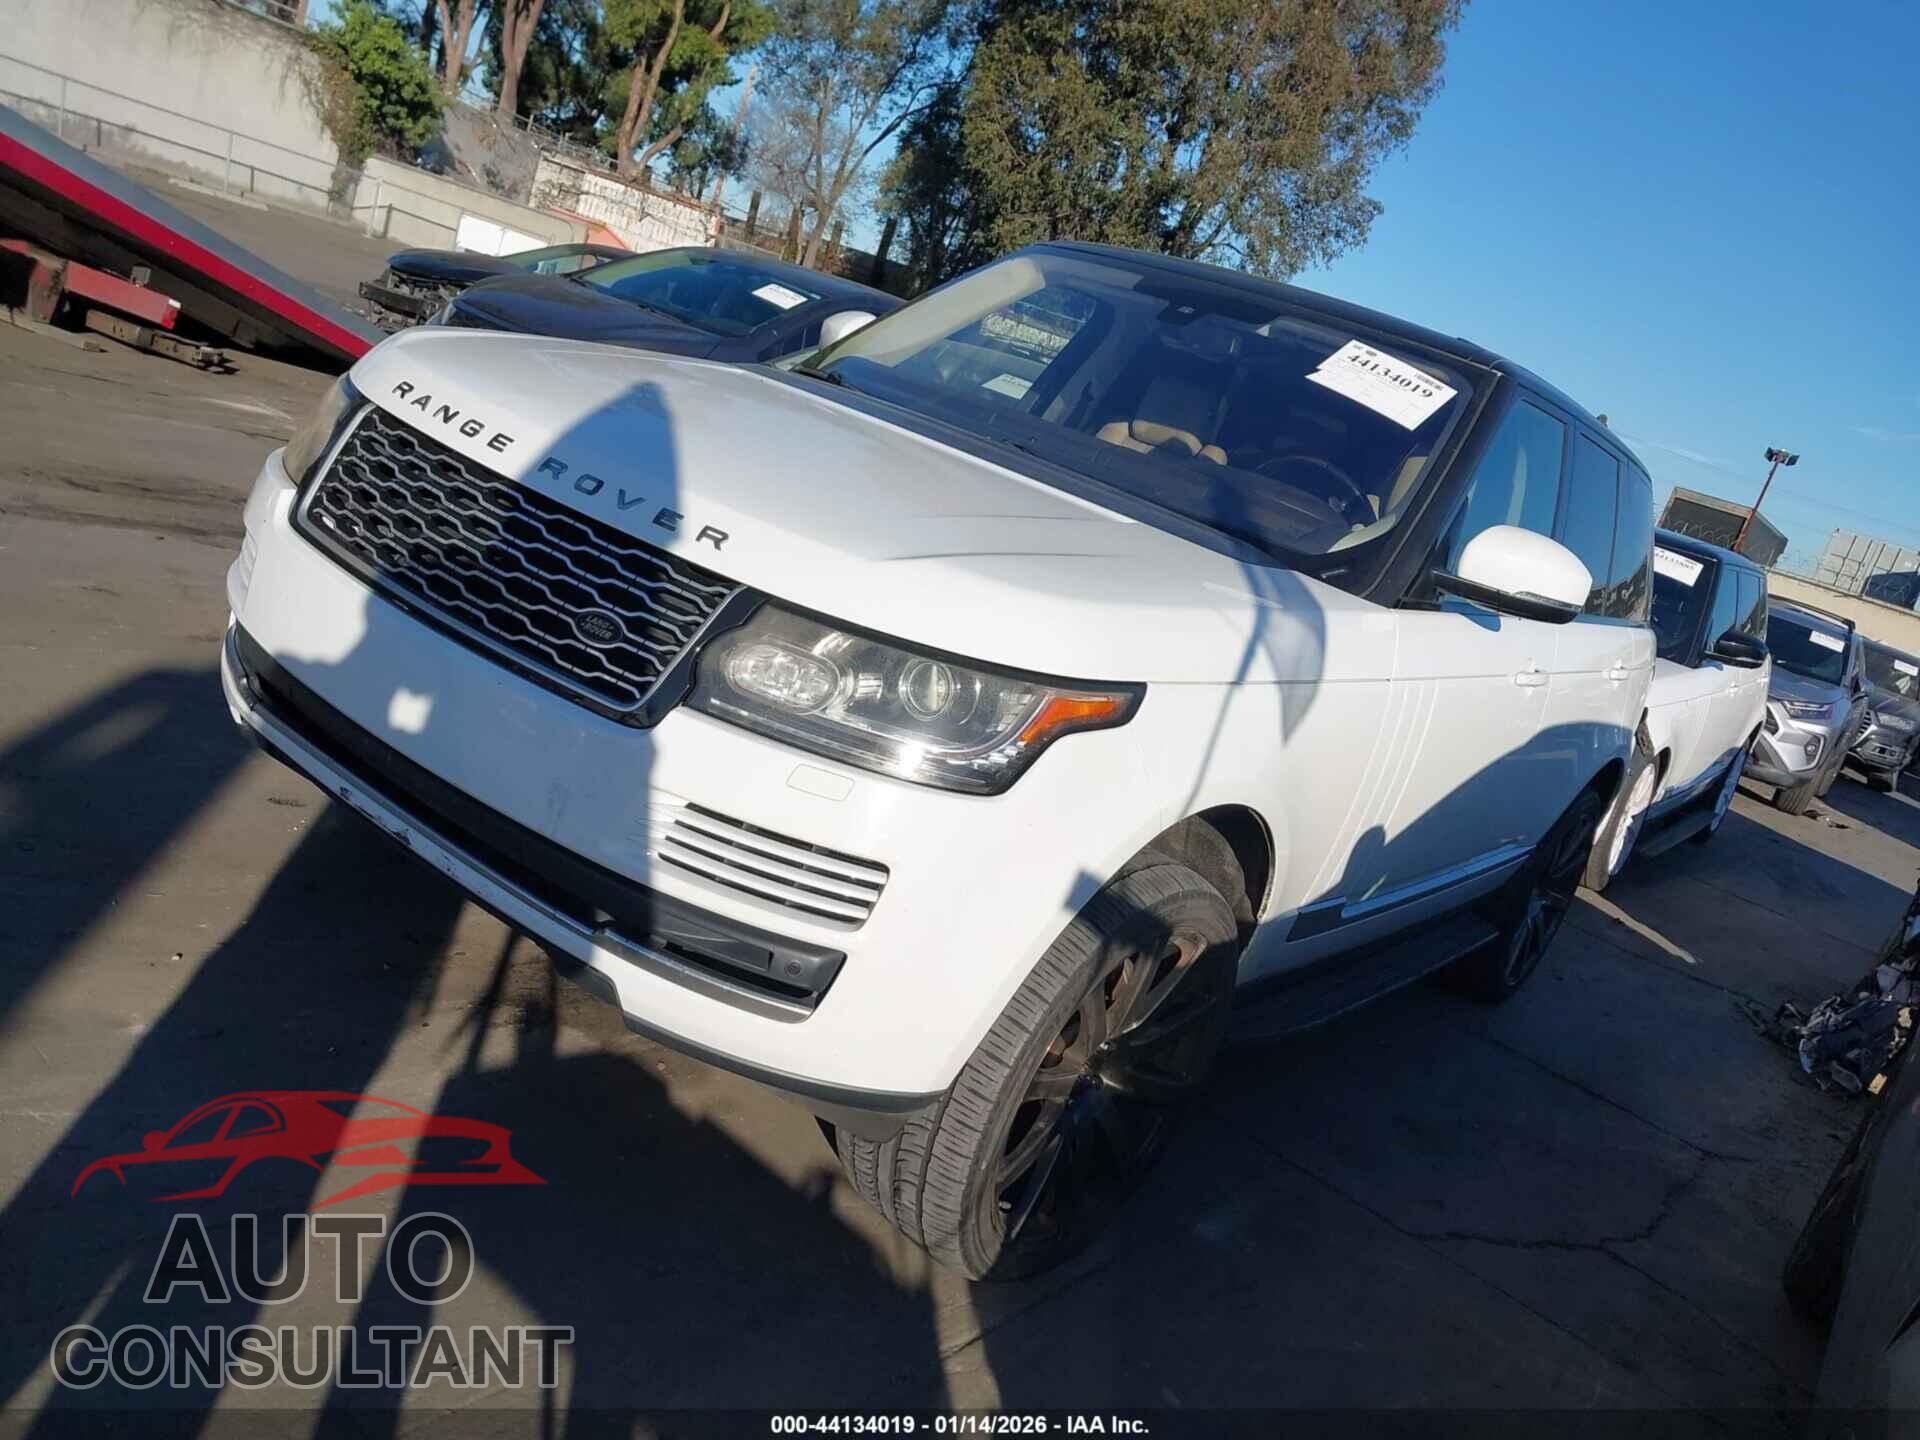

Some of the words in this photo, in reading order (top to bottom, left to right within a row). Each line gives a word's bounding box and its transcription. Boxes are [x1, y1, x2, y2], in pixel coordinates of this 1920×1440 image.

[1347, 355, 1433, 397] 44134019
[391, 381, 515, 453] RANGE
[537, 456, 729, 551] ROVER
